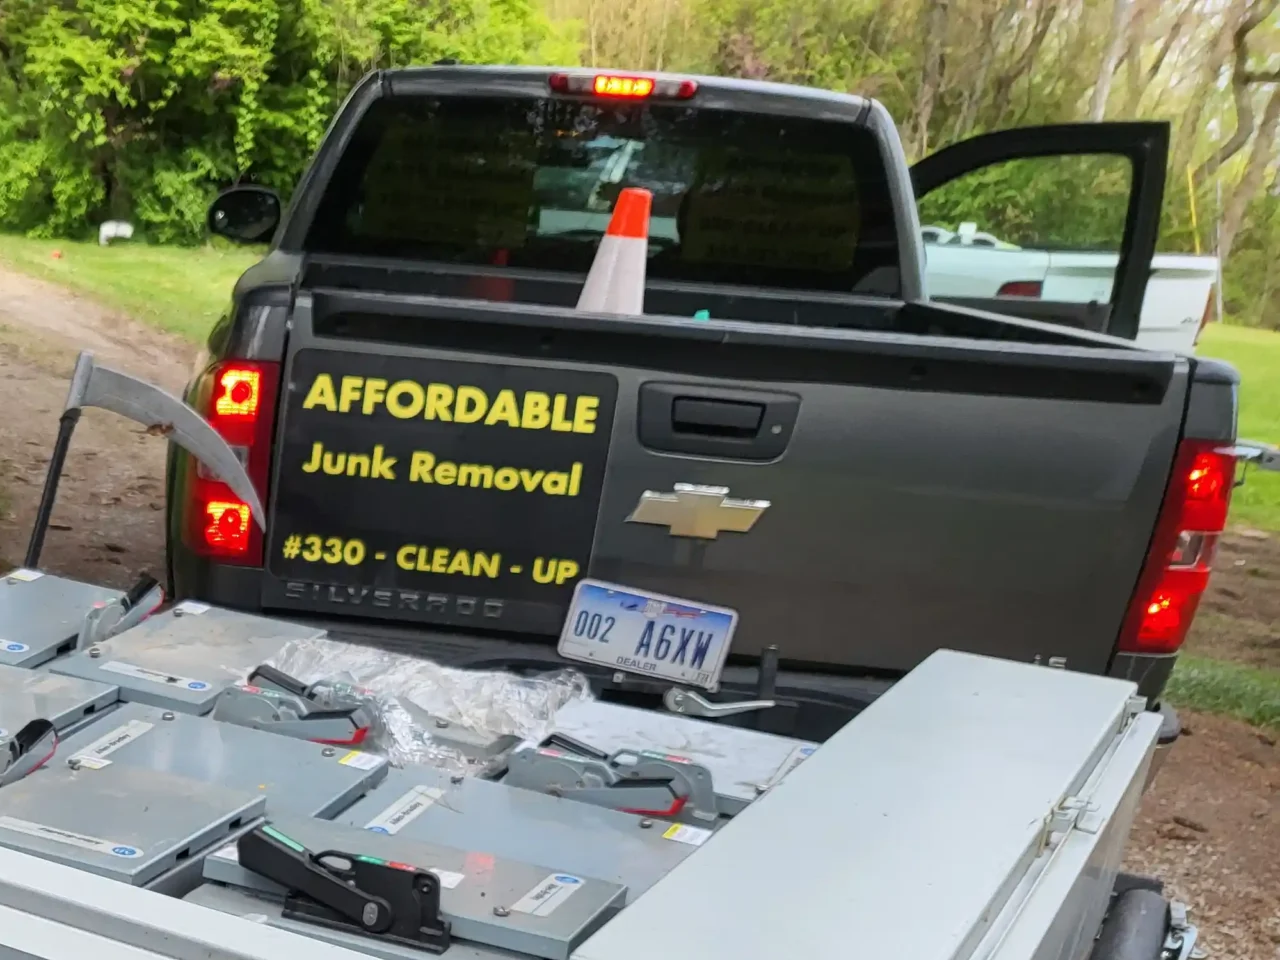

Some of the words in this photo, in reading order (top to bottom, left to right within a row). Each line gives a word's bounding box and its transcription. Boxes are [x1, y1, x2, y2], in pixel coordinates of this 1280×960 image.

[302, 373, 600, 434] AFFORDABLE
[302, 442, 398, 480] Junk
[409, 450, 583, 497] Removal
[282, 535, 365, 566] #330
[396, 545, 501, 579] CLEAN
[532, 557, 579, 585] UP
[285, 582, 504, 618] SILVERADO
[574, 610, 616, 643] 002
[633, 620, 714, 670] A6XW
[616, 656, 658, 672] DEALER
